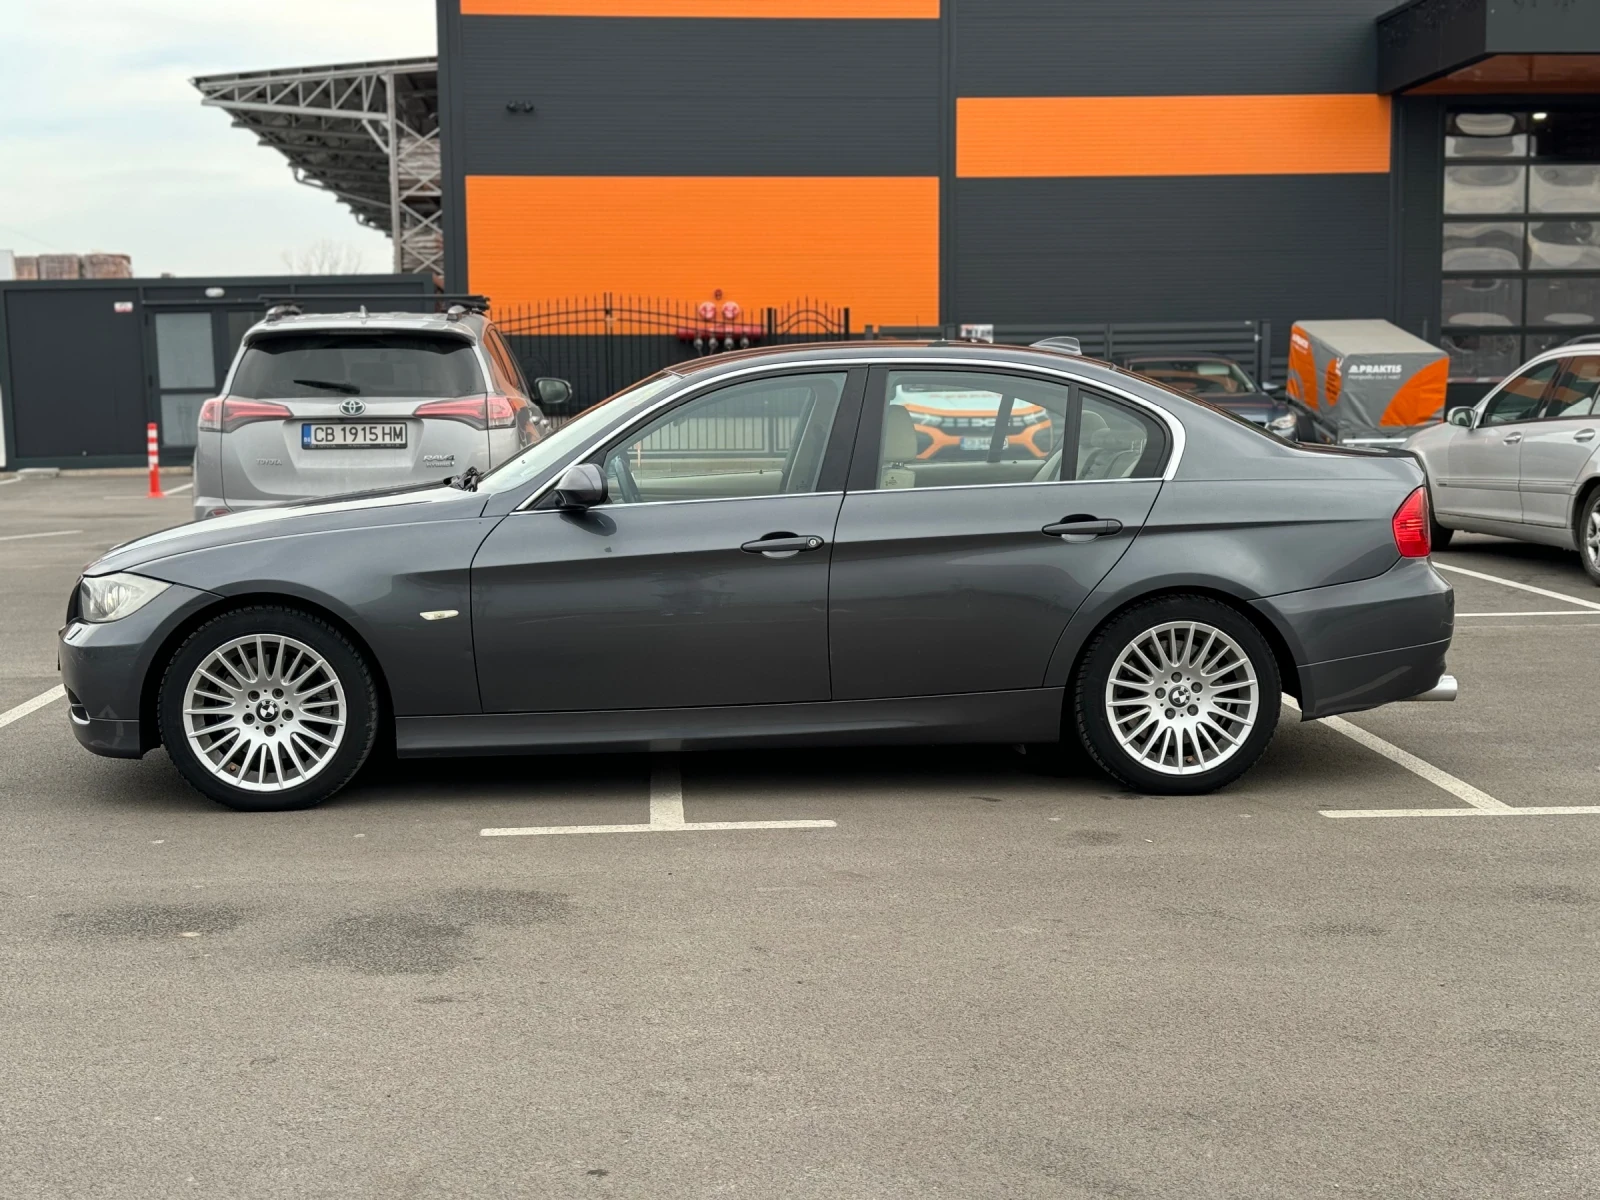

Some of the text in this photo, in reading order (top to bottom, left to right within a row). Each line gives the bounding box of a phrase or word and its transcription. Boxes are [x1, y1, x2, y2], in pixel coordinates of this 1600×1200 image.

[1359, 364, 1402, 374] PRAKTIS
[314, 425, 403, 443] CB 1915 HM
[255, 458, 283, 466] TOYOTA
[423, 454, 455, 462] RAV4
